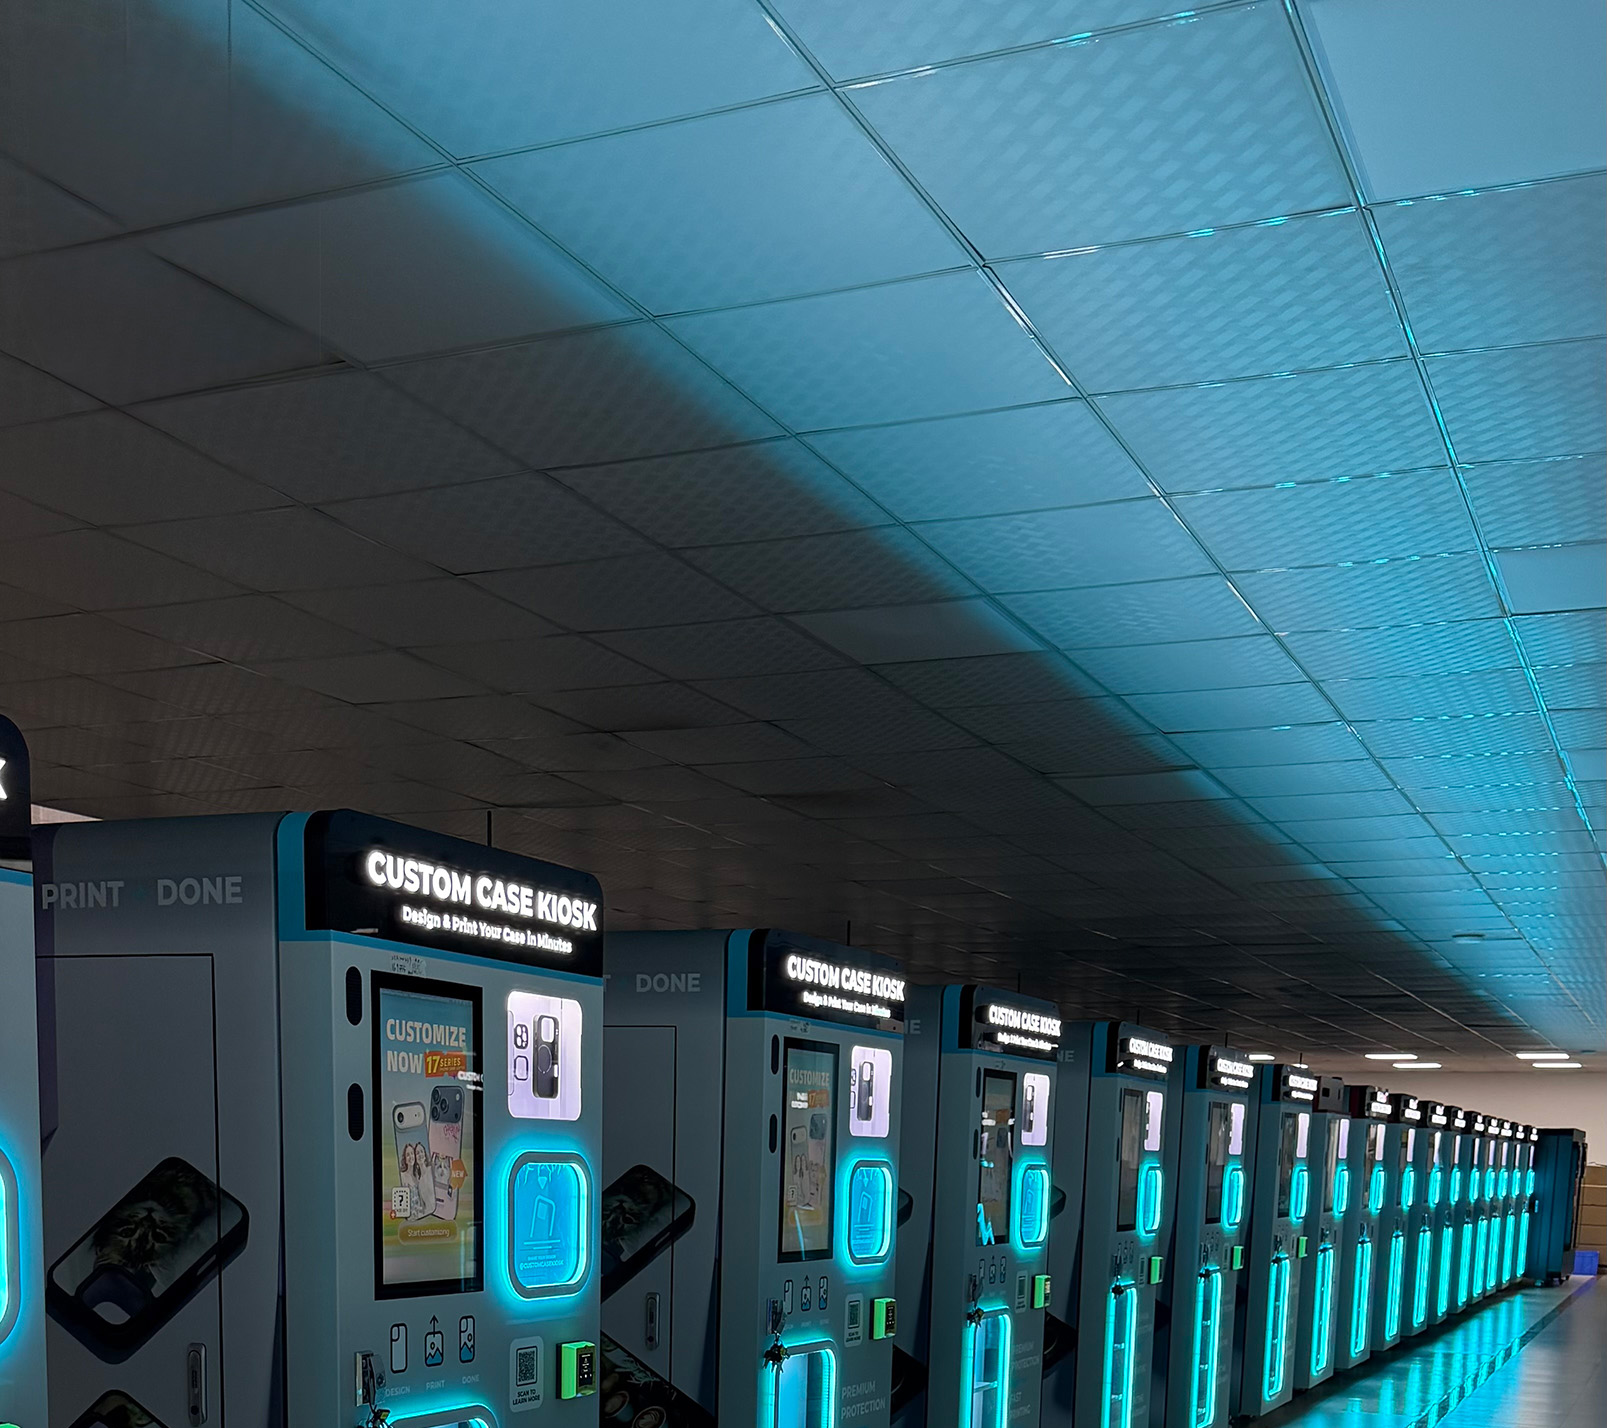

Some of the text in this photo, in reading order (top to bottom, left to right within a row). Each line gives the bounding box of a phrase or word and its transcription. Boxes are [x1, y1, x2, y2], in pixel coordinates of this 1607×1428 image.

[41, 876, 243, 910] PRINT DONE
[367, 851, 598, 931] CUSTOM CASE KIOSK
[403, 906, 441, 929] Design
[443, 914, 452, 929] &
[452, 917, 478, 935] Print
[478, 921, 503, 940] Your
[503, 927, 525, 944] Case
[537, 933, 572, 954] Minutes
[636, 973, 701, 993] DONE
[787, 955, 905, 1002] CUSTOM CASE KIOSK
[989, 1005, 1021, 1029] CUSTOM
[386, 1018, 466, 1048] CUSTOMIZE
[387, 1050, 461, 1074] NOW 17 SERIES
[790, 1068, 829, 1087] CUSTOMIZE
[385, 1374, 480, 1397] DESIGN PRINT DONE
[841, 1380, 876, 1400] PREMIUM
[512, 1397, 527, 1406] LEARN
[841, 1397, 886, 1420] PROTECTION
